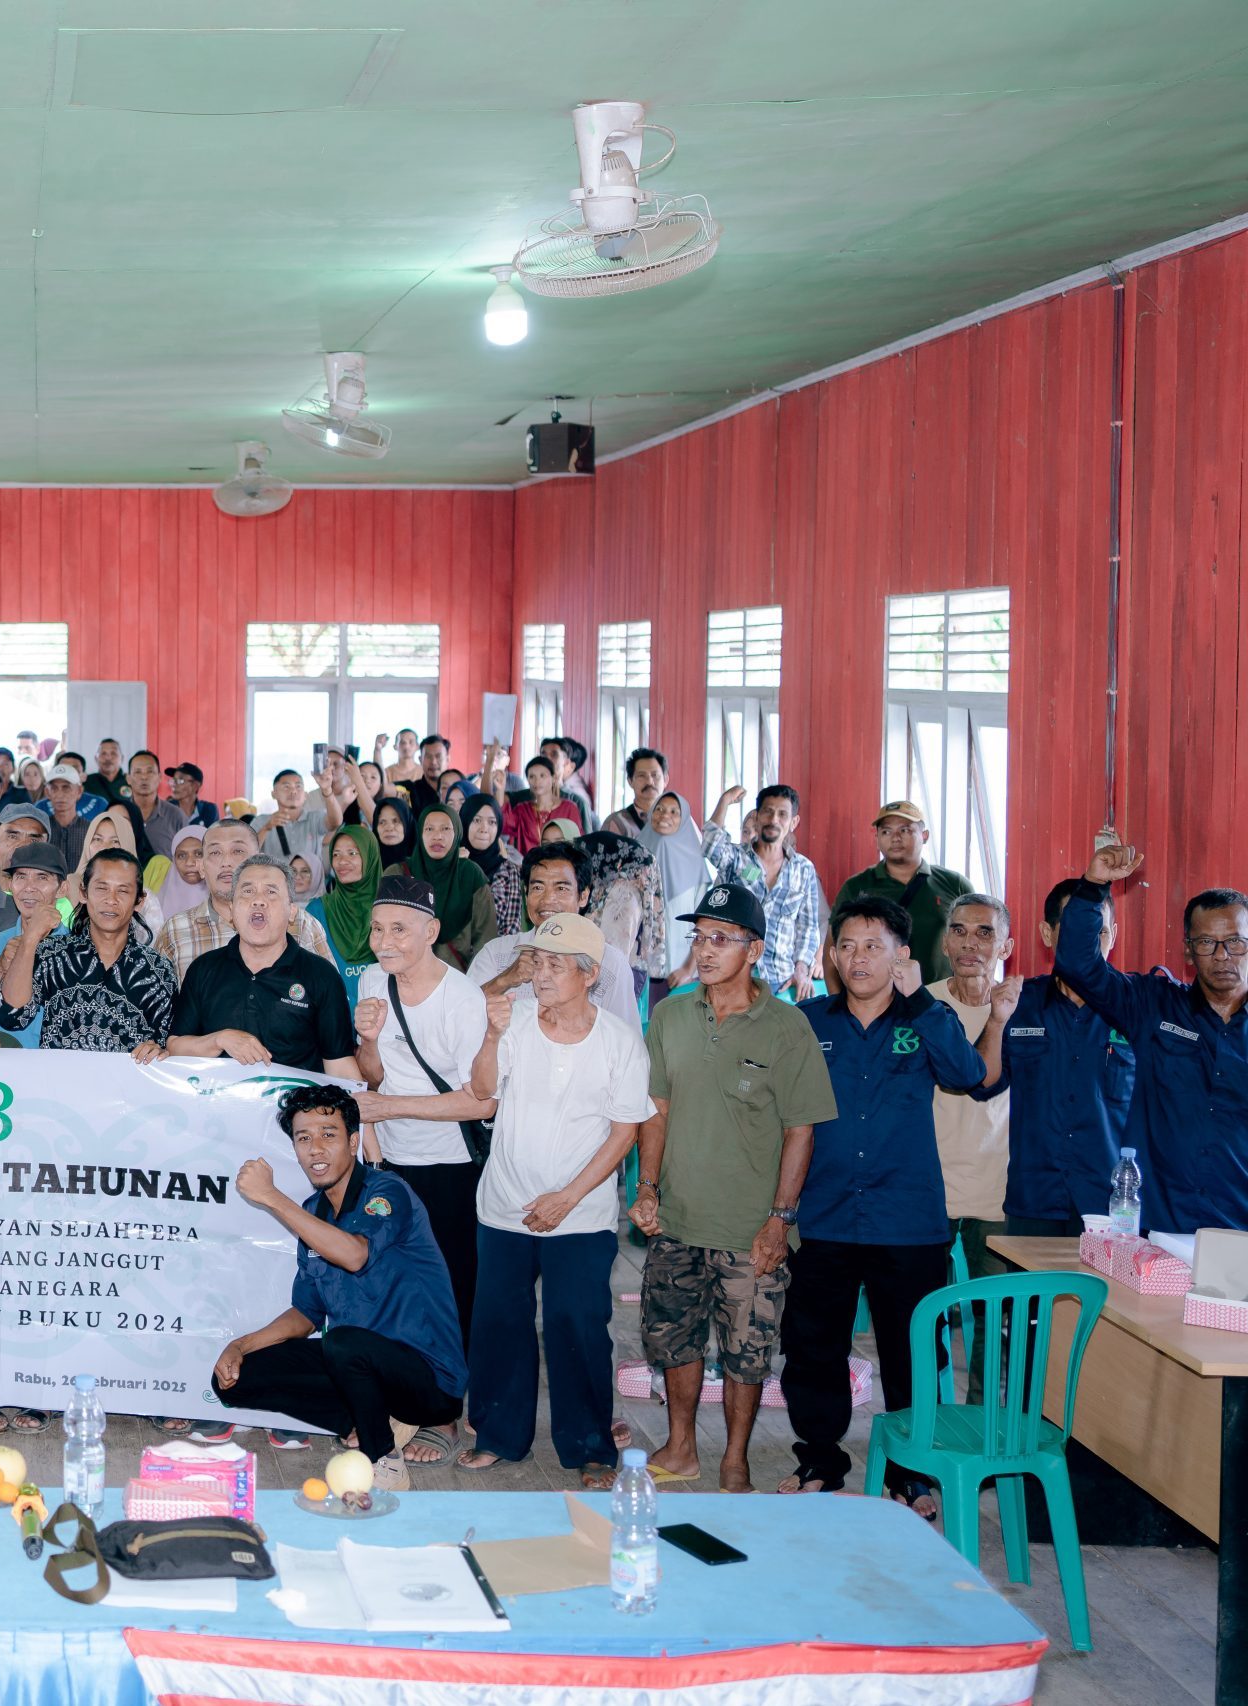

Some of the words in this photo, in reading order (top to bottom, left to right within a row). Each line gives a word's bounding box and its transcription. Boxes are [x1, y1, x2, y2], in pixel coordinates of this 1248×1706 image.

[2, 1162, 229, 1204] TAHUNAN
[50, 1219, 200, 1243] SEJAHTERA
[54, 1252, 165, 1271] JANGGUT
[17, 1309, 102, 1328] BUKU
[116, 1311, 184, 1333] 2024
[14, 1371, 56, 1387] Rabu,
[86, 1376, 147, 1390] ebruari
[152, 1380, 187, 1393] 2025
